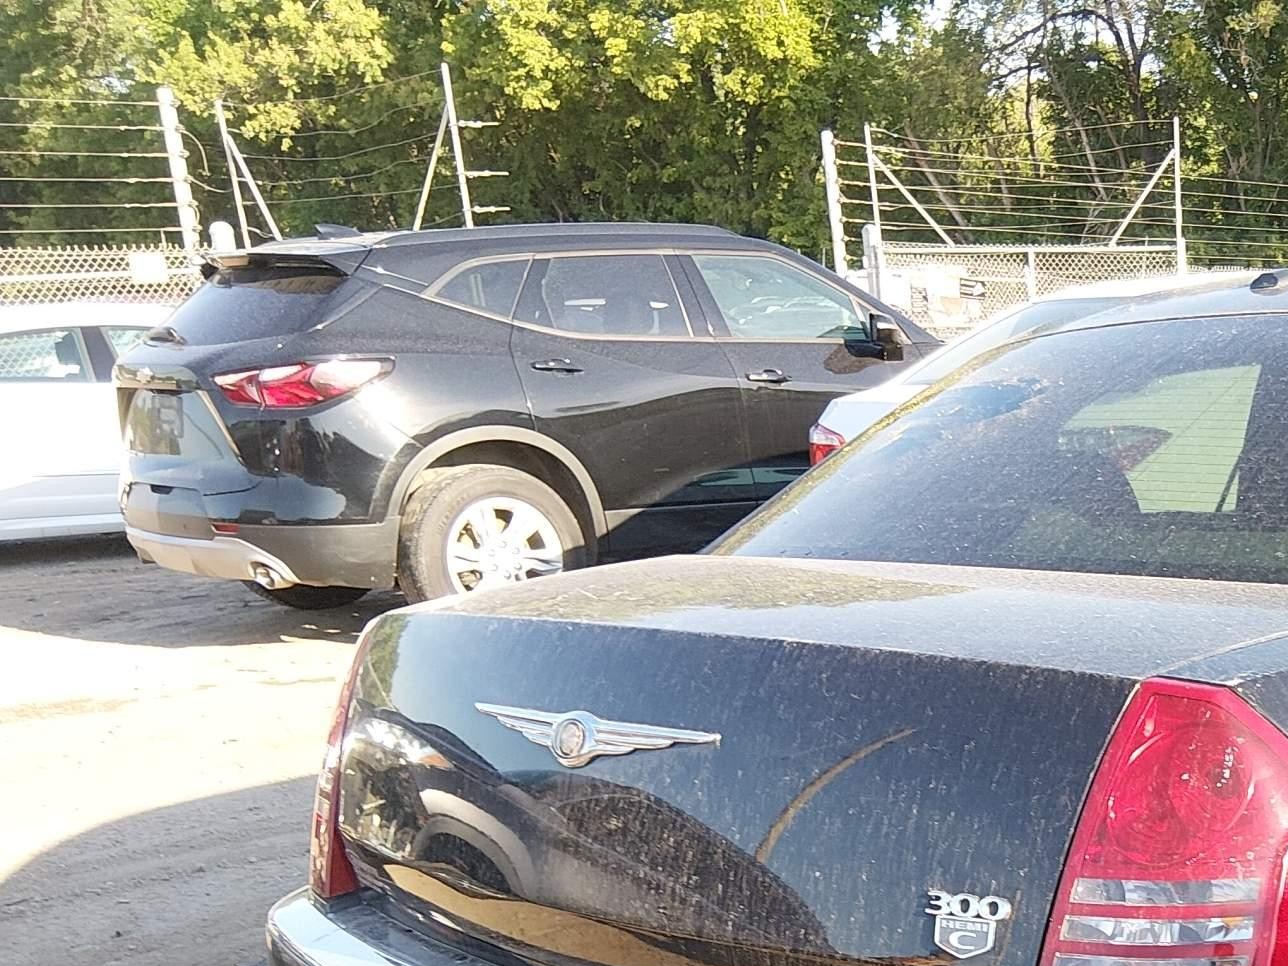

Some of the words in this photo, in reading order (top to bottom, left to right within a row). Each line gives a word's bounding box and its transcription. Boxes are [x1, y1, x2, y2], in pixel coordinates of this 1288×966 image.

[924, 890, 1012, 920] 300
[941, 919, 989, 932] HEMI
[949, 931, 977, 950] C
